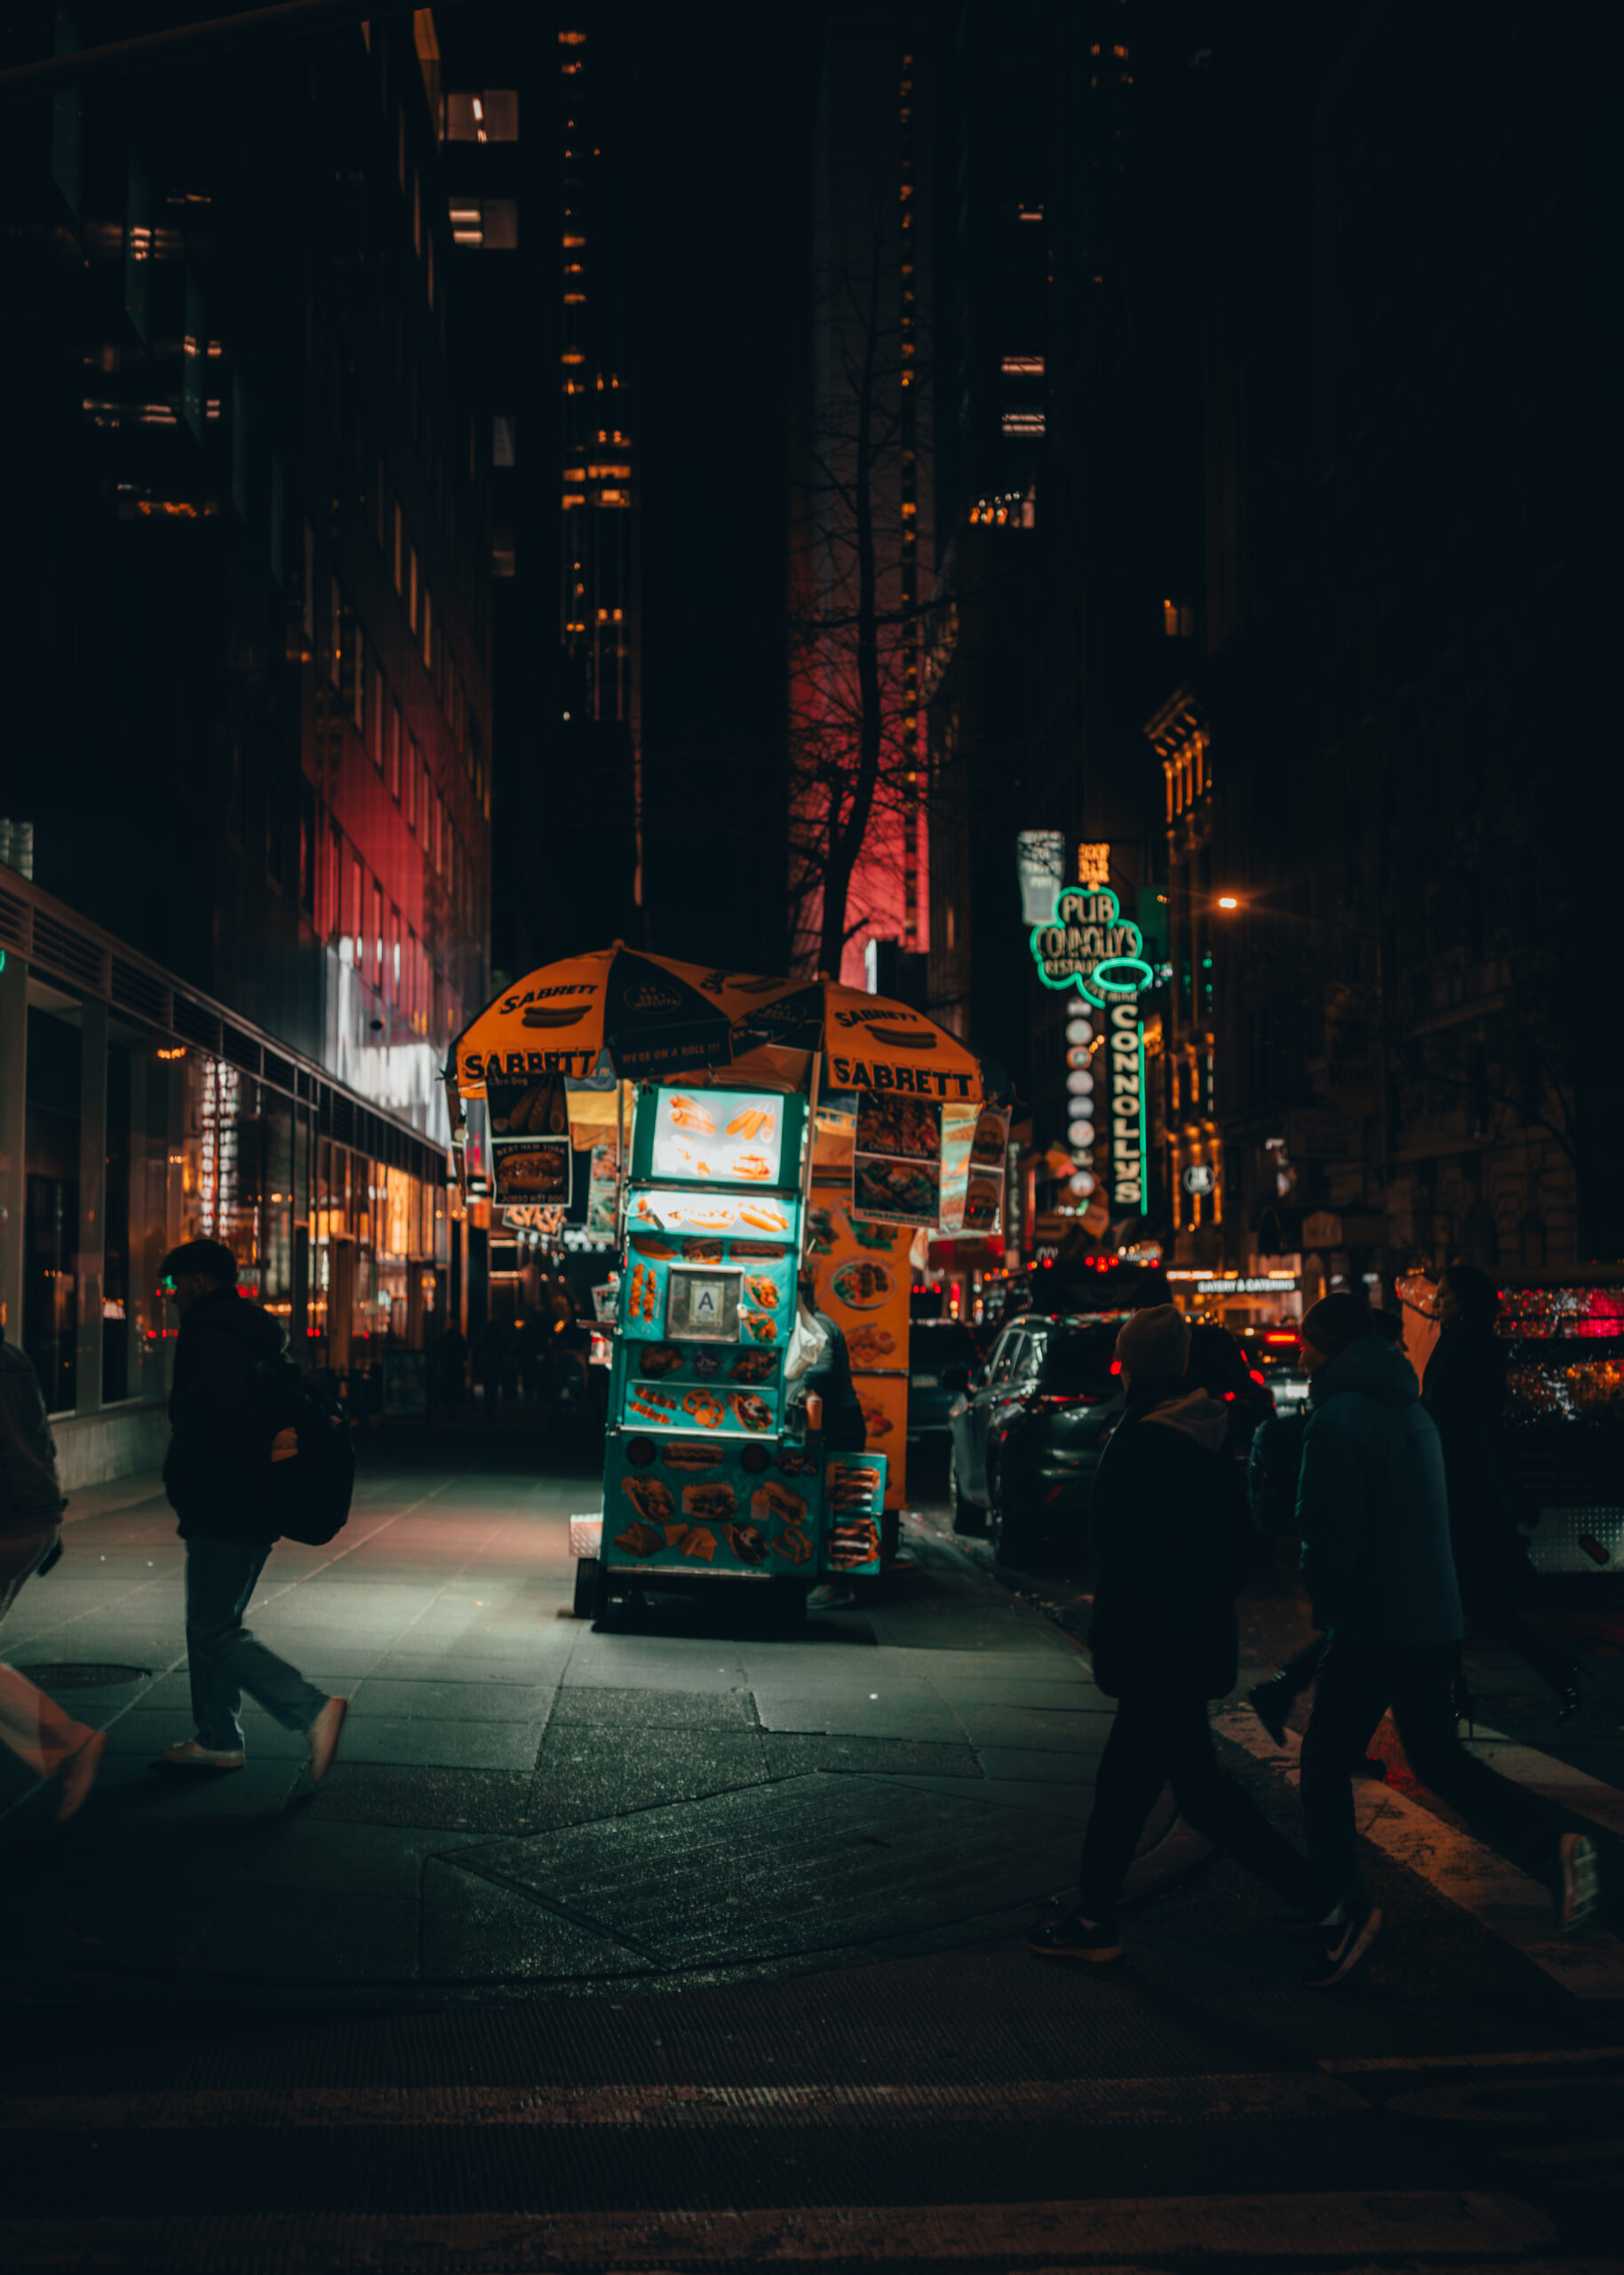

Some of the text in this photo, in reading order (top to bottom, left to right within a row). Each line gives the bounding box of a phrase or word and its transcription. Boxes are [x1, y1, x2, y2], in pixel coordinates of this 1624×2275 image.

[1063, 894, 1115, 924] PUB
[1037, 925, 1138, 958] CONNOLLY'S
[500, 985, 598, 1015] SABRETT
[834, 1008, 919, 1028] SABRETT
[465, 1050, 596, 1080] SABRETT
[622, 1052, 650, 1065] WE'RE
[654, 1049, 668, 1060] ON
[671, 1047, 679, 1058] A
[681, 1044, 705, 1057] ROLL
[511, 1076, 529, 1088] Dog
[832, 1058, 973, 1098] SABRETT
[1111, 1003, 1142, 1204] CONNOLLY'S
[529, 1194, 545, 1203] HOT
[547, 1194, 564, 1203] DOG
[698, 1291, 714, 1310] A
